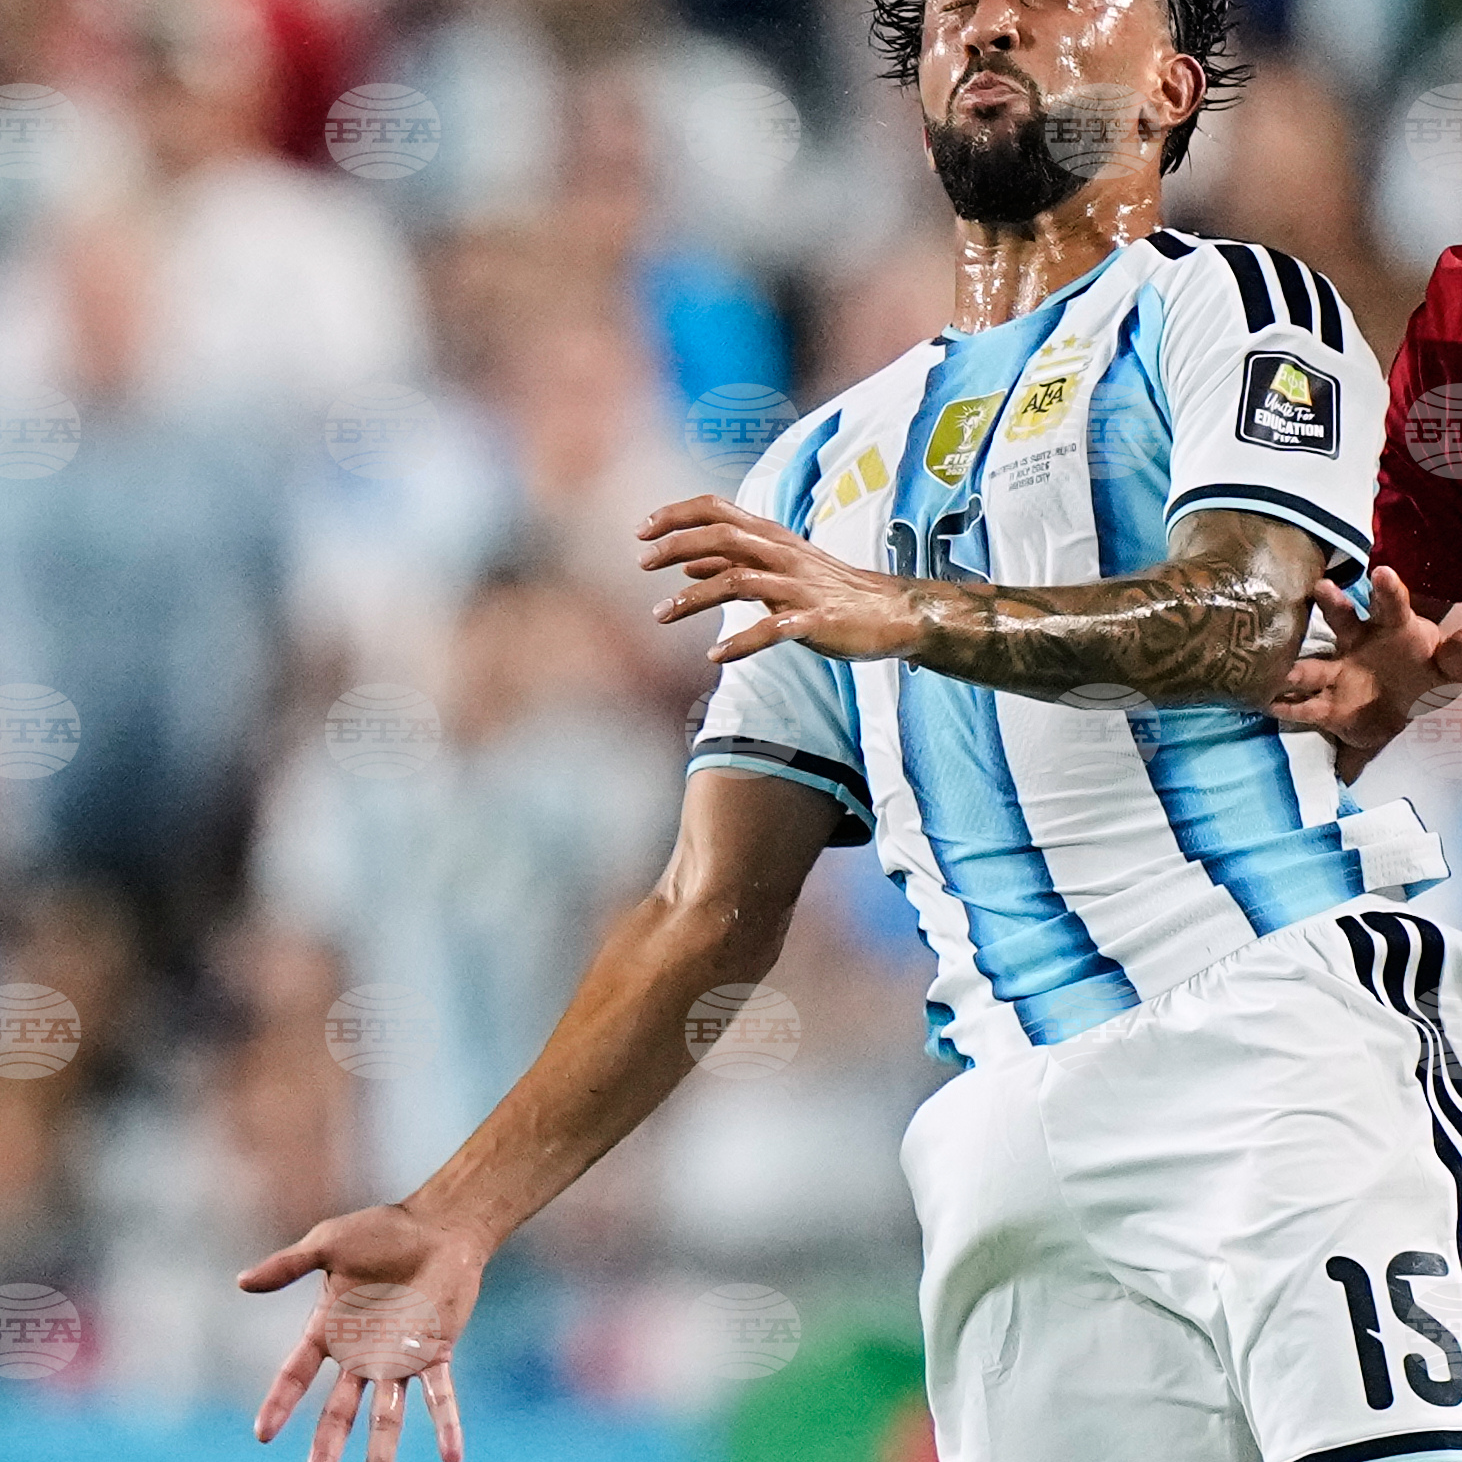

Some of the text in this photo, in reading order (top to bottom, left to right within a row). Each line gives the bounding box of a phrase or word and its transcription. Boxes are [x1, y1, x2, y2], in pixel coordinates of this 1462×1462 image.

[1022, 378, 1067, 414] AFA
[1254, 408, 1325, 438] EDUCATION
[1272, 431, 1302, 444] FIFA
